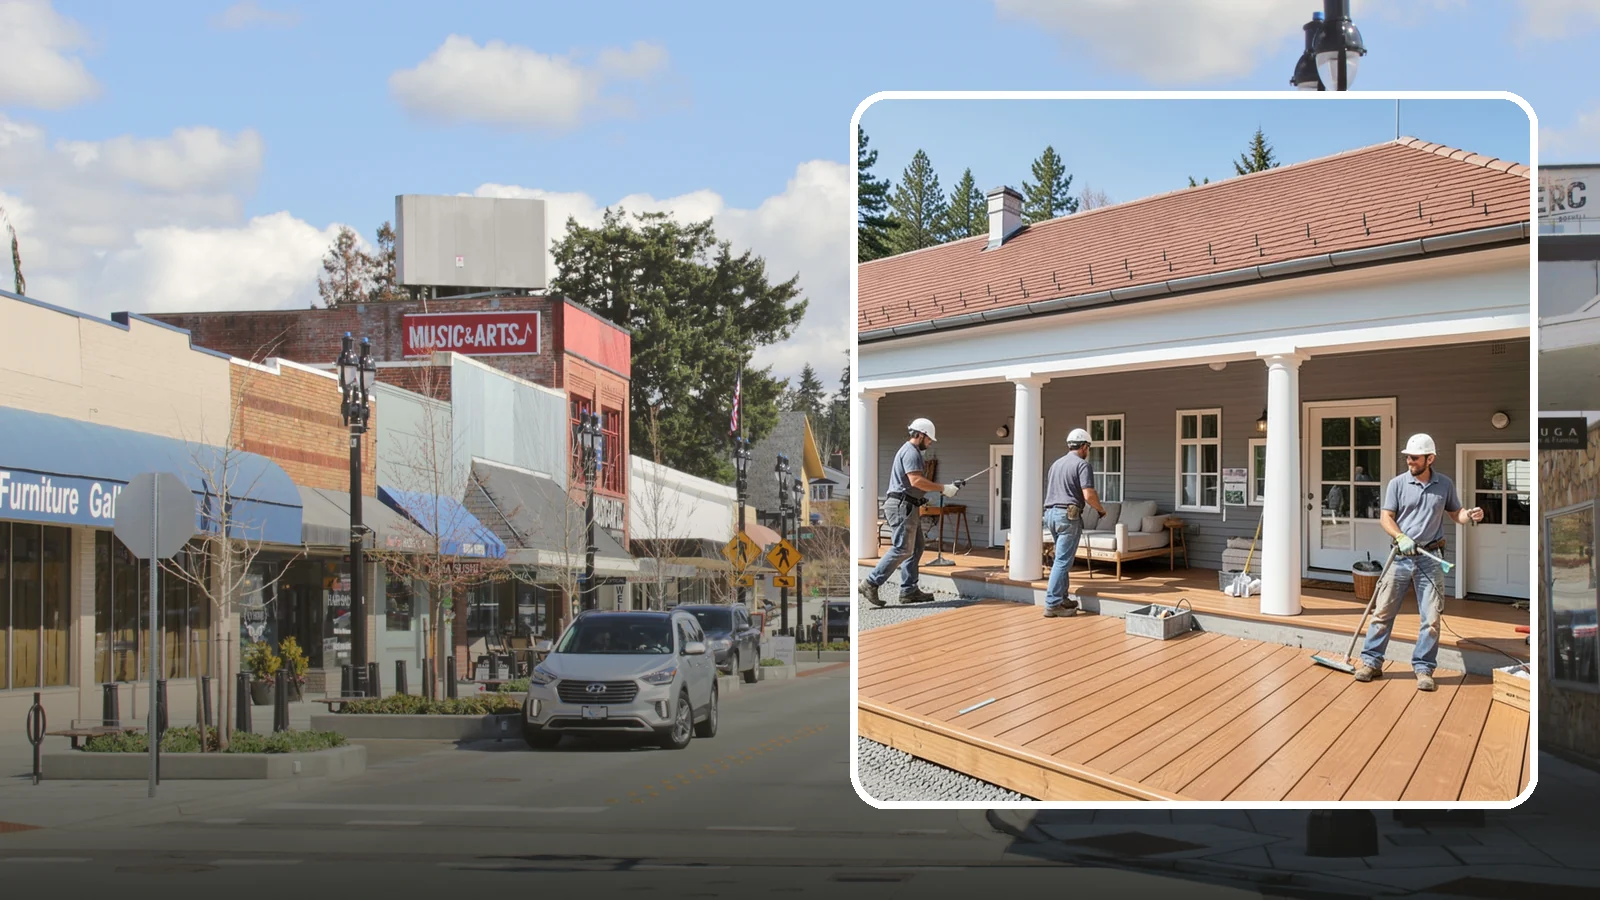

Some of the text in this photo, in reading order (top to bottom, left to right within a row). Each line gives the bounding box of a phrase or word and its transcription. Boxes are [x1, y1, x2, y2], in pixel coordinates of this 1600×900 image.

[409, 323, 519, 349] MUSIC&ARTS
[1540, 427, 1577, 437] UGA
[0, 471, 79, 516] Furniture
[453, 563, 479, 574] SUSHI
